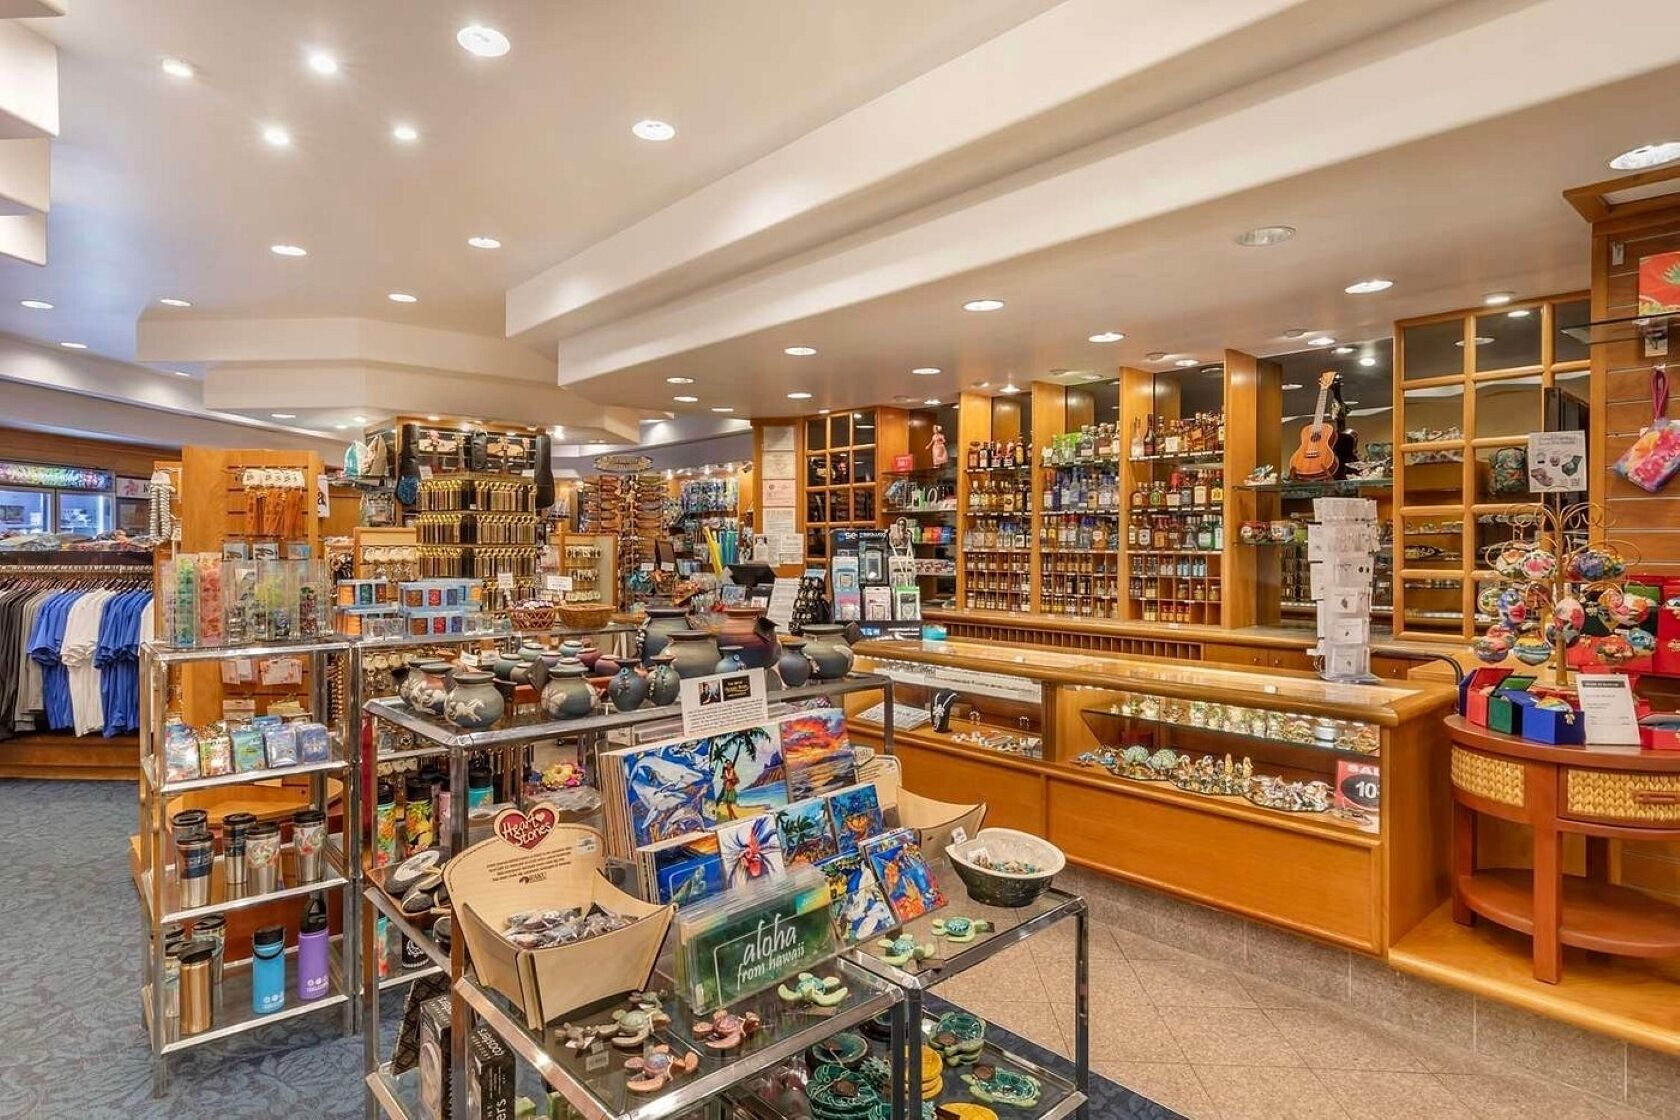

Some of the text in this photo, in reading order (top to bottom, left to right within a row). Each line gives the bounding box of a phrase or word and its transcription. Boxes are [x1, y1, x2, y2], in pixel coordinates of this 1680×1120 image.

[1347, 763, 1380, 777] SAL
[502, 815, 537, 840] Heart
[514, 823, 551, 847] Stones
[743, 913, 797, 965] aloha
[737, 942, 805, 991] from hawaii
